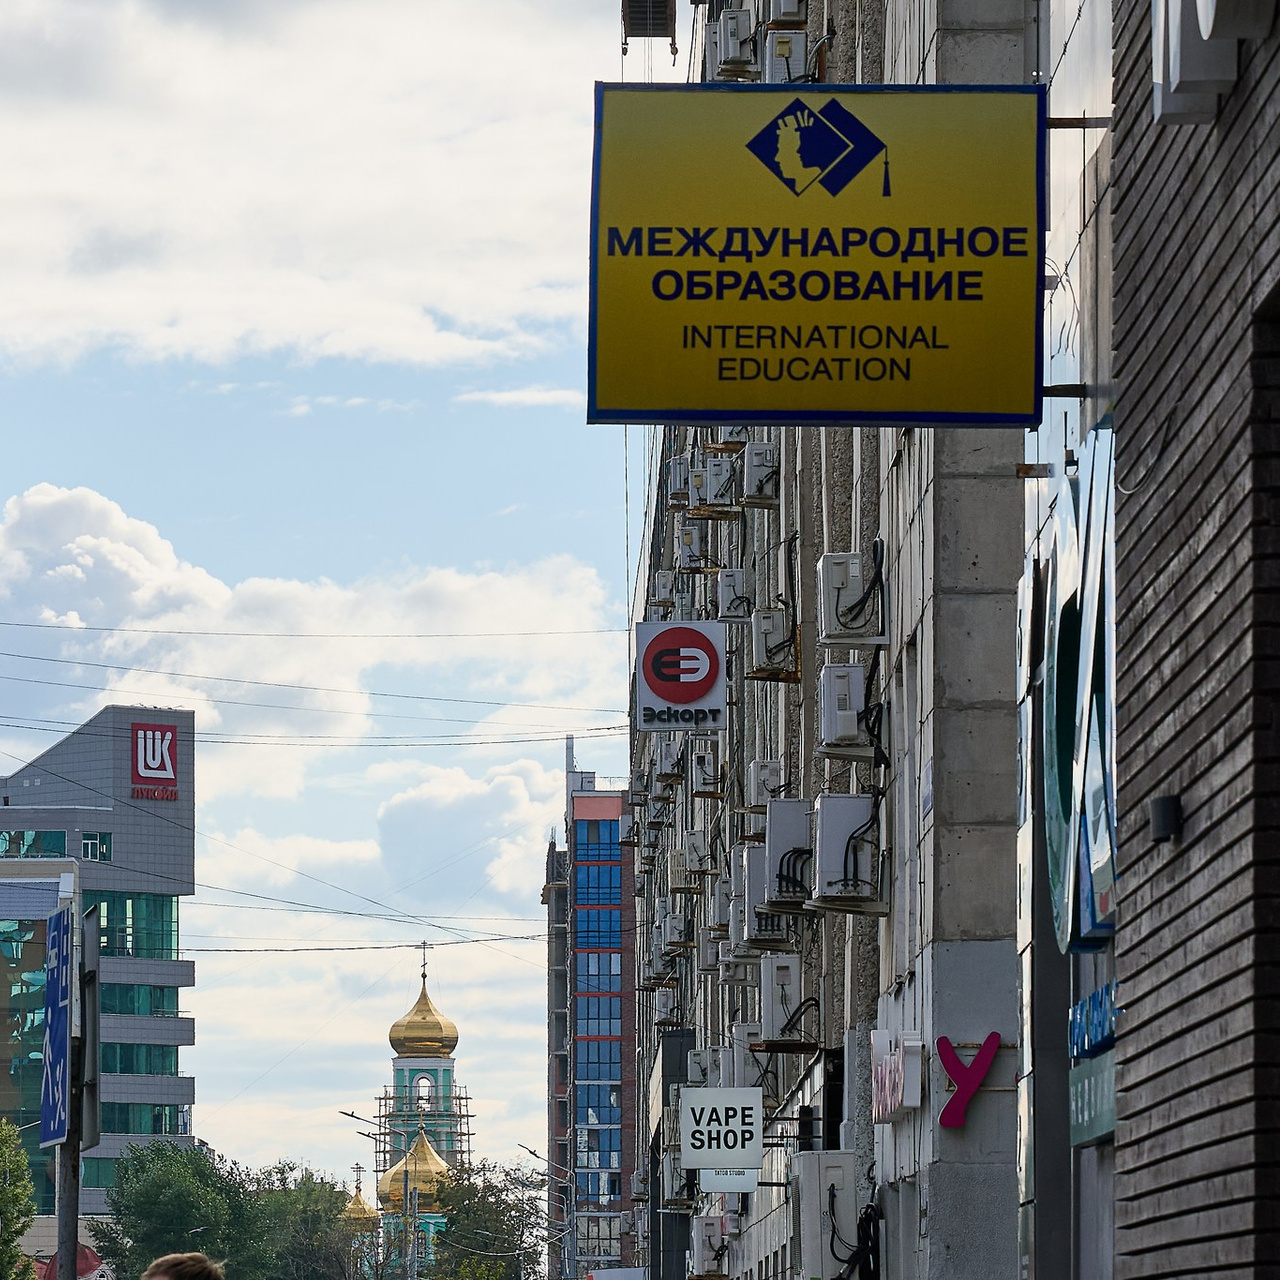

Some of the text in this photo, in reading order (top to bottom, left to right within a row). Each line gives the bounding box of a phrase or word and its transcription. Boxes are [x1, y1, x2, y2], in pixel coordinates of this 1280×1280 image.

[607, 226, 1028, 263] МЕЖДУНАРОДНОЕ
[651, 269, 984, 301] ОБРАЗОВАНИЕ
[682, 325, 949, 349] INTERNATIONAL
[717, 357, 912, 381] EDUCATION
[643, 706, 721, 725] Эскорт
[131, 787, 178, 801] ЛУКОЙЛ
[689, 1106, 754, 1127] VAPE
[690, 1129, 754, 1150] SHOP
